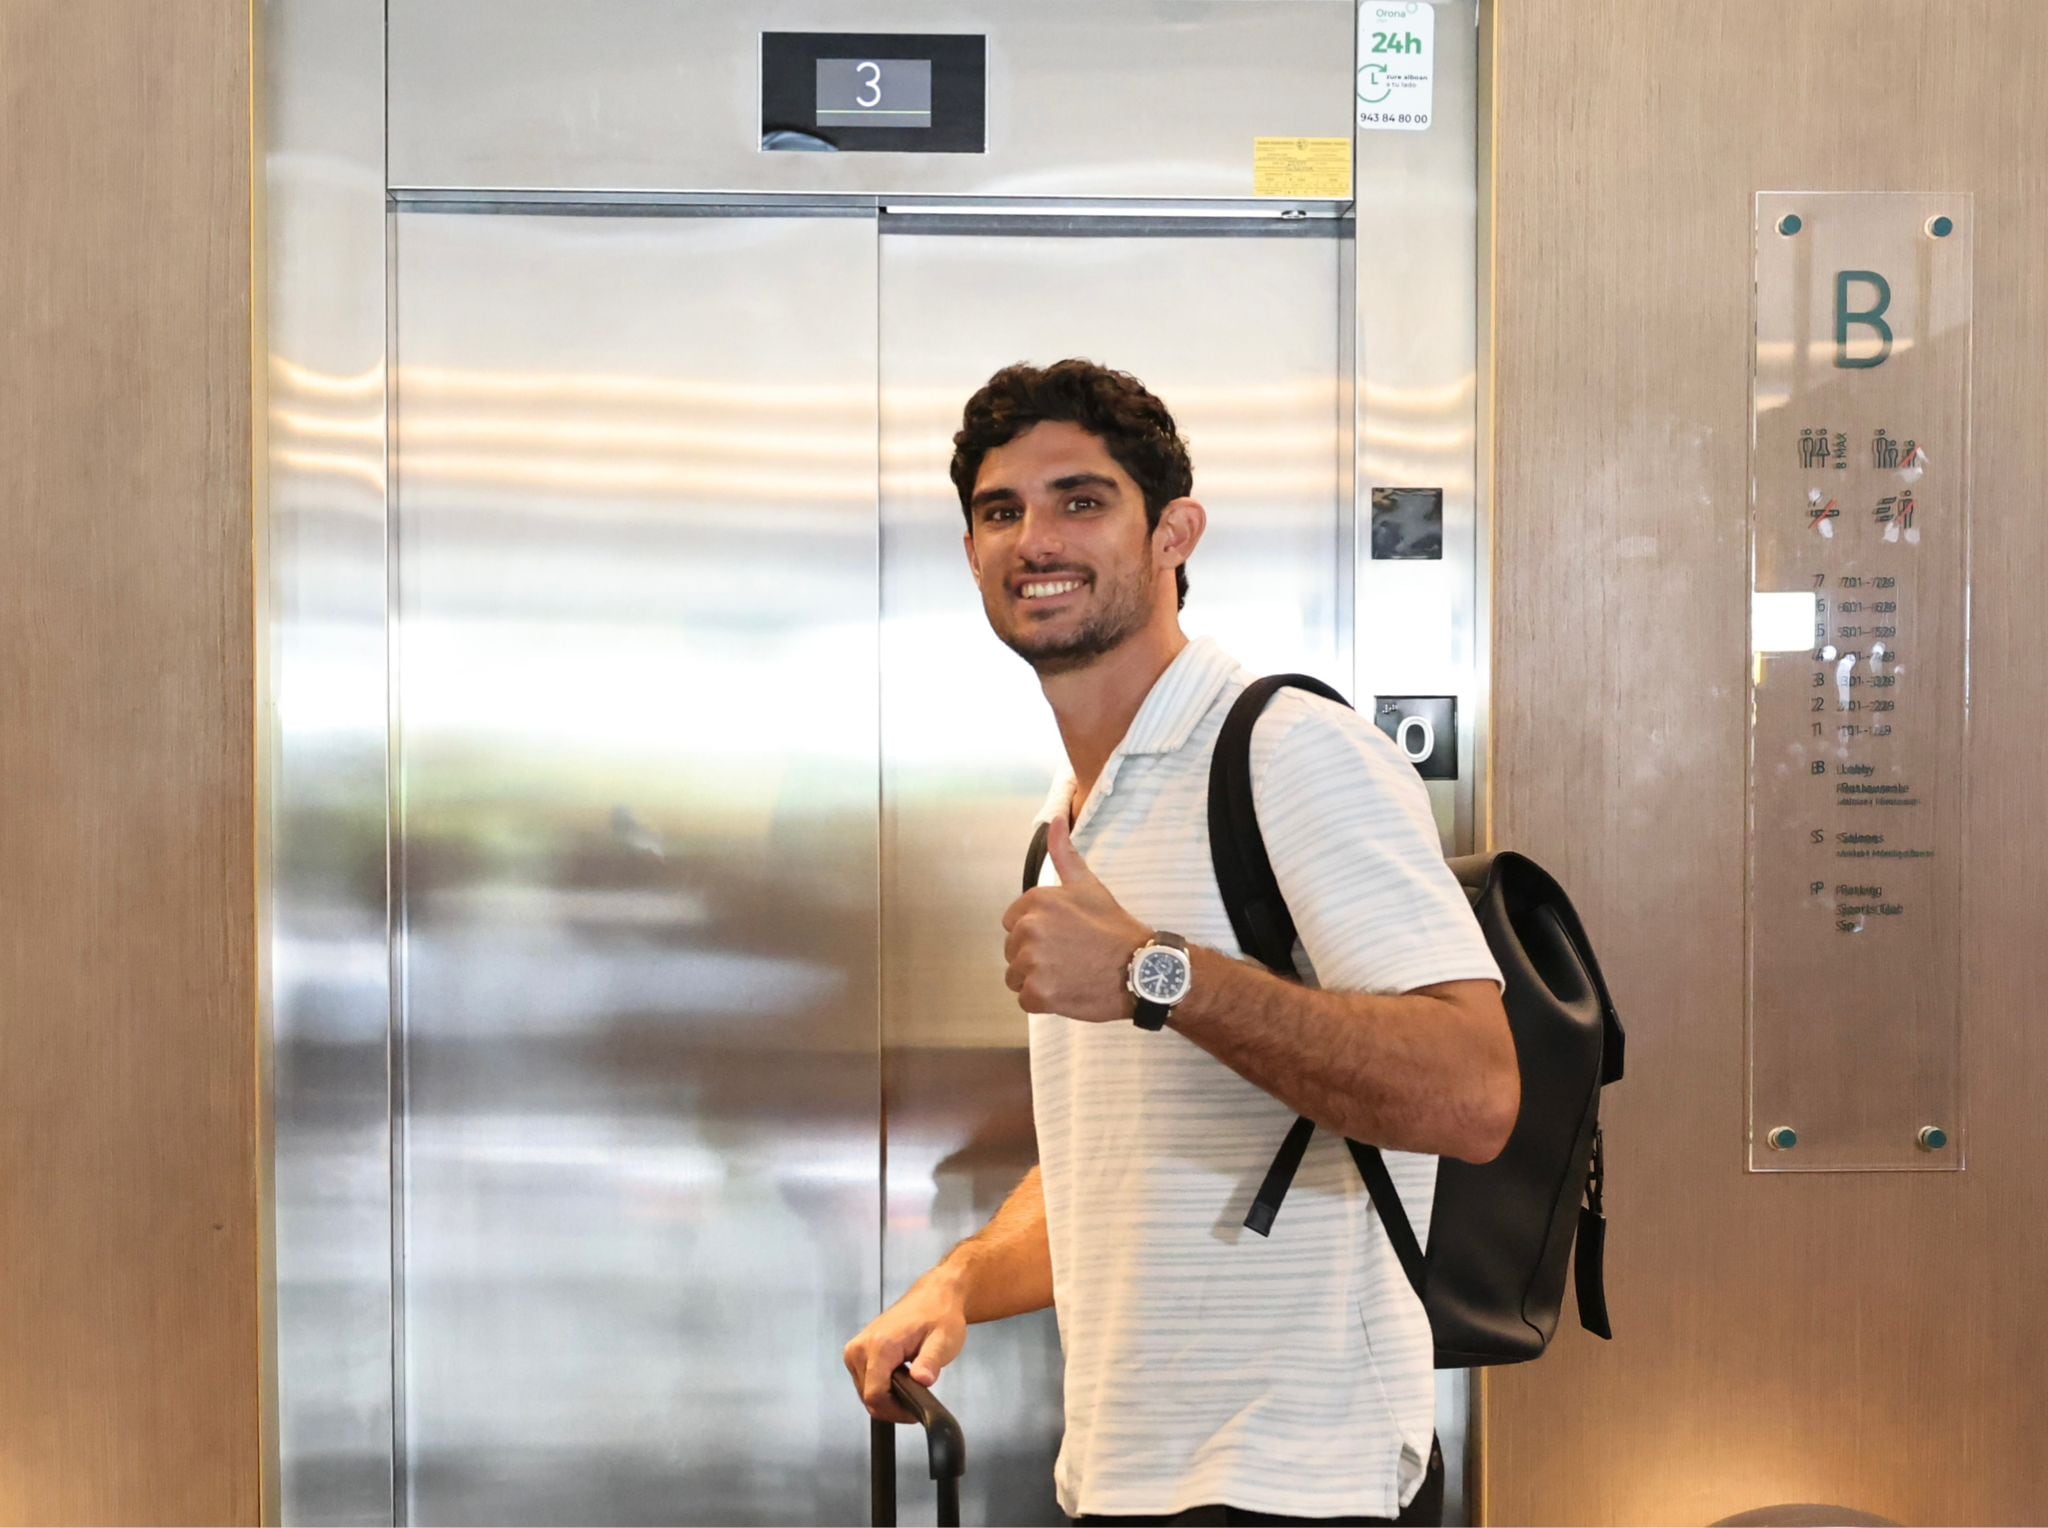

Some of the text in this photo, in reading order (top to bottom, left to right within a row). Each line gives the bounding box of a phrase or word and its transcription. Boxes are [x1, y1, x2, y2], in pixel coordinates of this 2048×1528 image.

[1376, 8, 1406, 18] Orona
[1371, 32, 1422, 54] 24h
[856, 61, 881, 107] 3
[1360, 113, 1428, 123] 943 84 80 00
[1836, 270, 1893, 369] B
[1813, 573, 1825, 588] 7
[1816, 598, 1826, 613] 6
[1816, 623, 1826, 637] 5
[1813, 672, 1825, 687] 3
[1812, 697, 1825, 712] 2
[1397, 716, 1434, 763] 0
[1812, 761, 1825, 775] B
